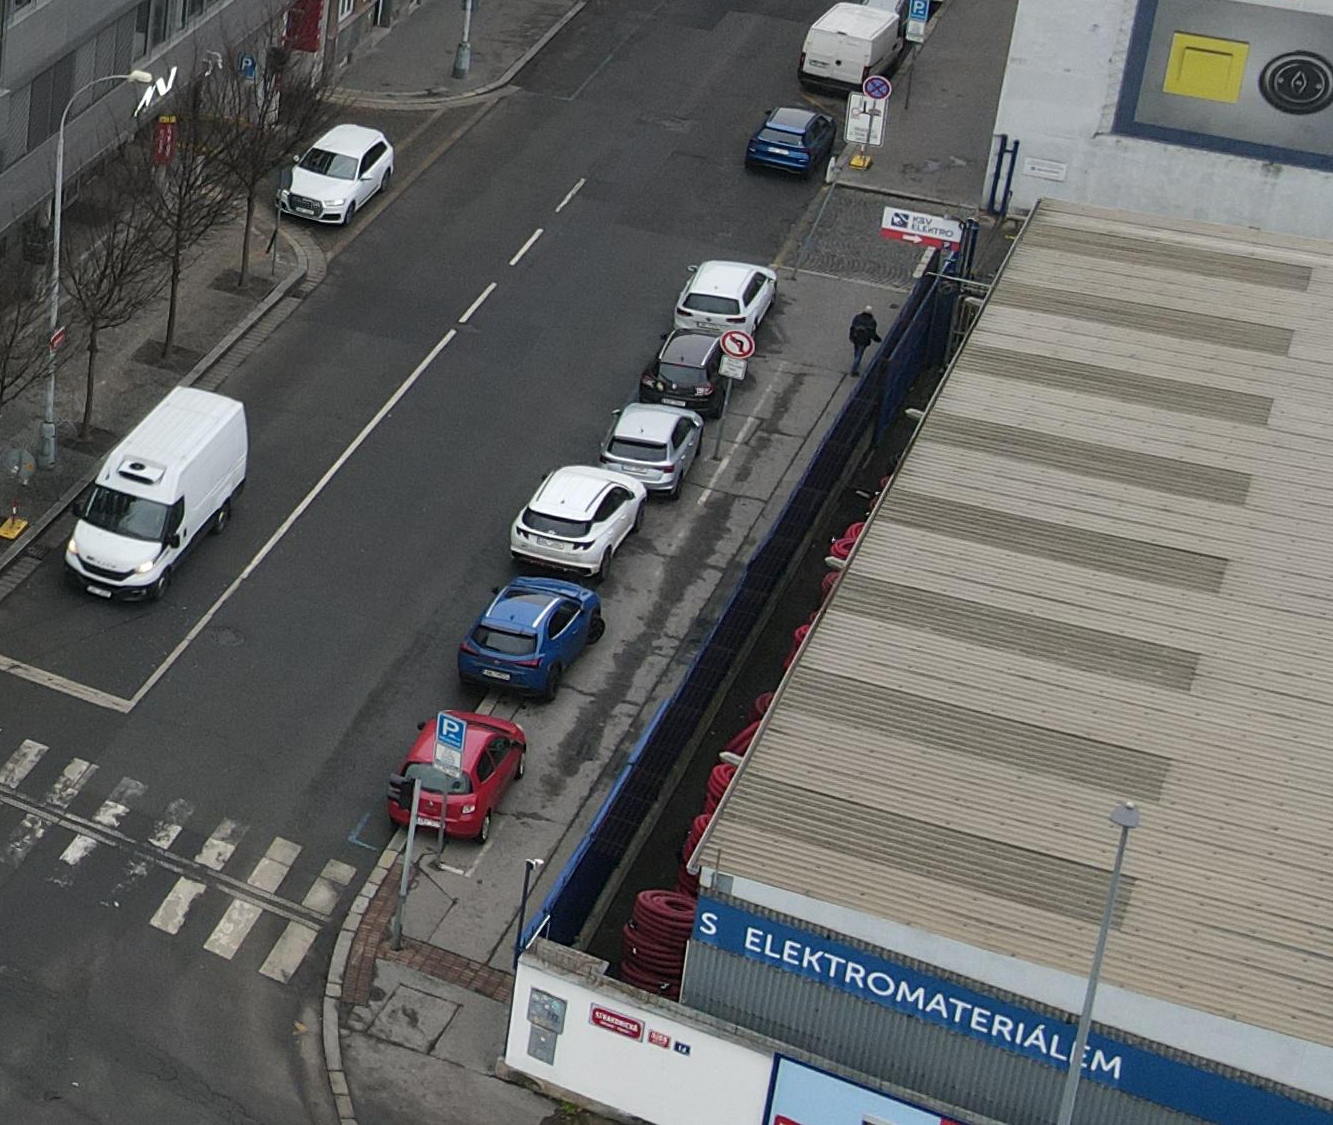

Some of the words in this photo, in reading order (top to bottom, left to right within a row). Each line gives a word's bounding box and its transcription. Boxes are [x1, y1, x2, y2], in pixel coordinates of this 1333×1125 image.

[911, 224, 954, 238] ELEKTRO
[442, 718, 459, 736] P
[699, 911, 718, 935] S
[744, 926, 1122, 1080] ELEKTROMATERIÁLEM
